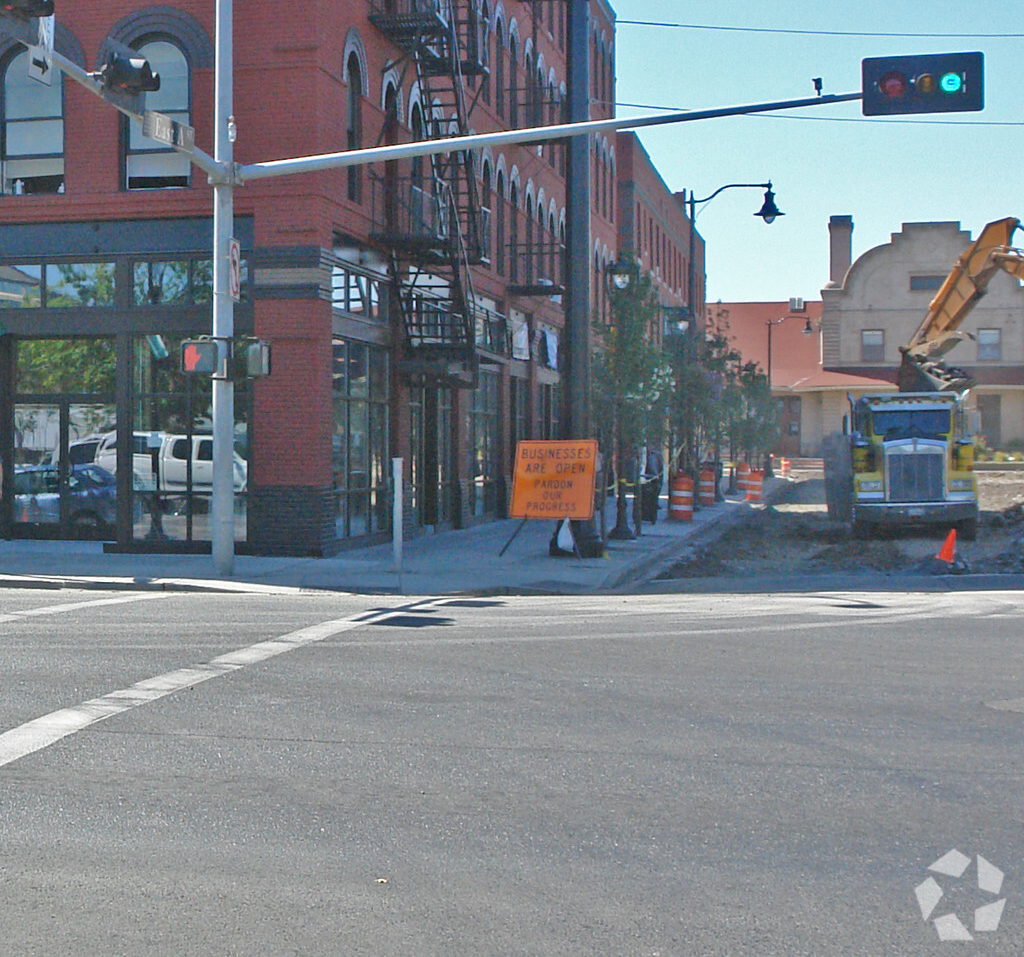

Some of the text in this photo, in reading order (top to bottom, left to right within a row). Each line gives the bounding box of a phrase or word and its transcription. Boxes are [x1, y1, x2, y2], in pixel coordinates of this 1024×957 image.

[521, 448, 592, 460] BUSINESSES
[525, 462, 586, 475] ARE OPEN
[534, 479, 574, 490] PARDON
[542, 490, 563, 501] OUR
[525, 501, 577, 513] PROGRESS
